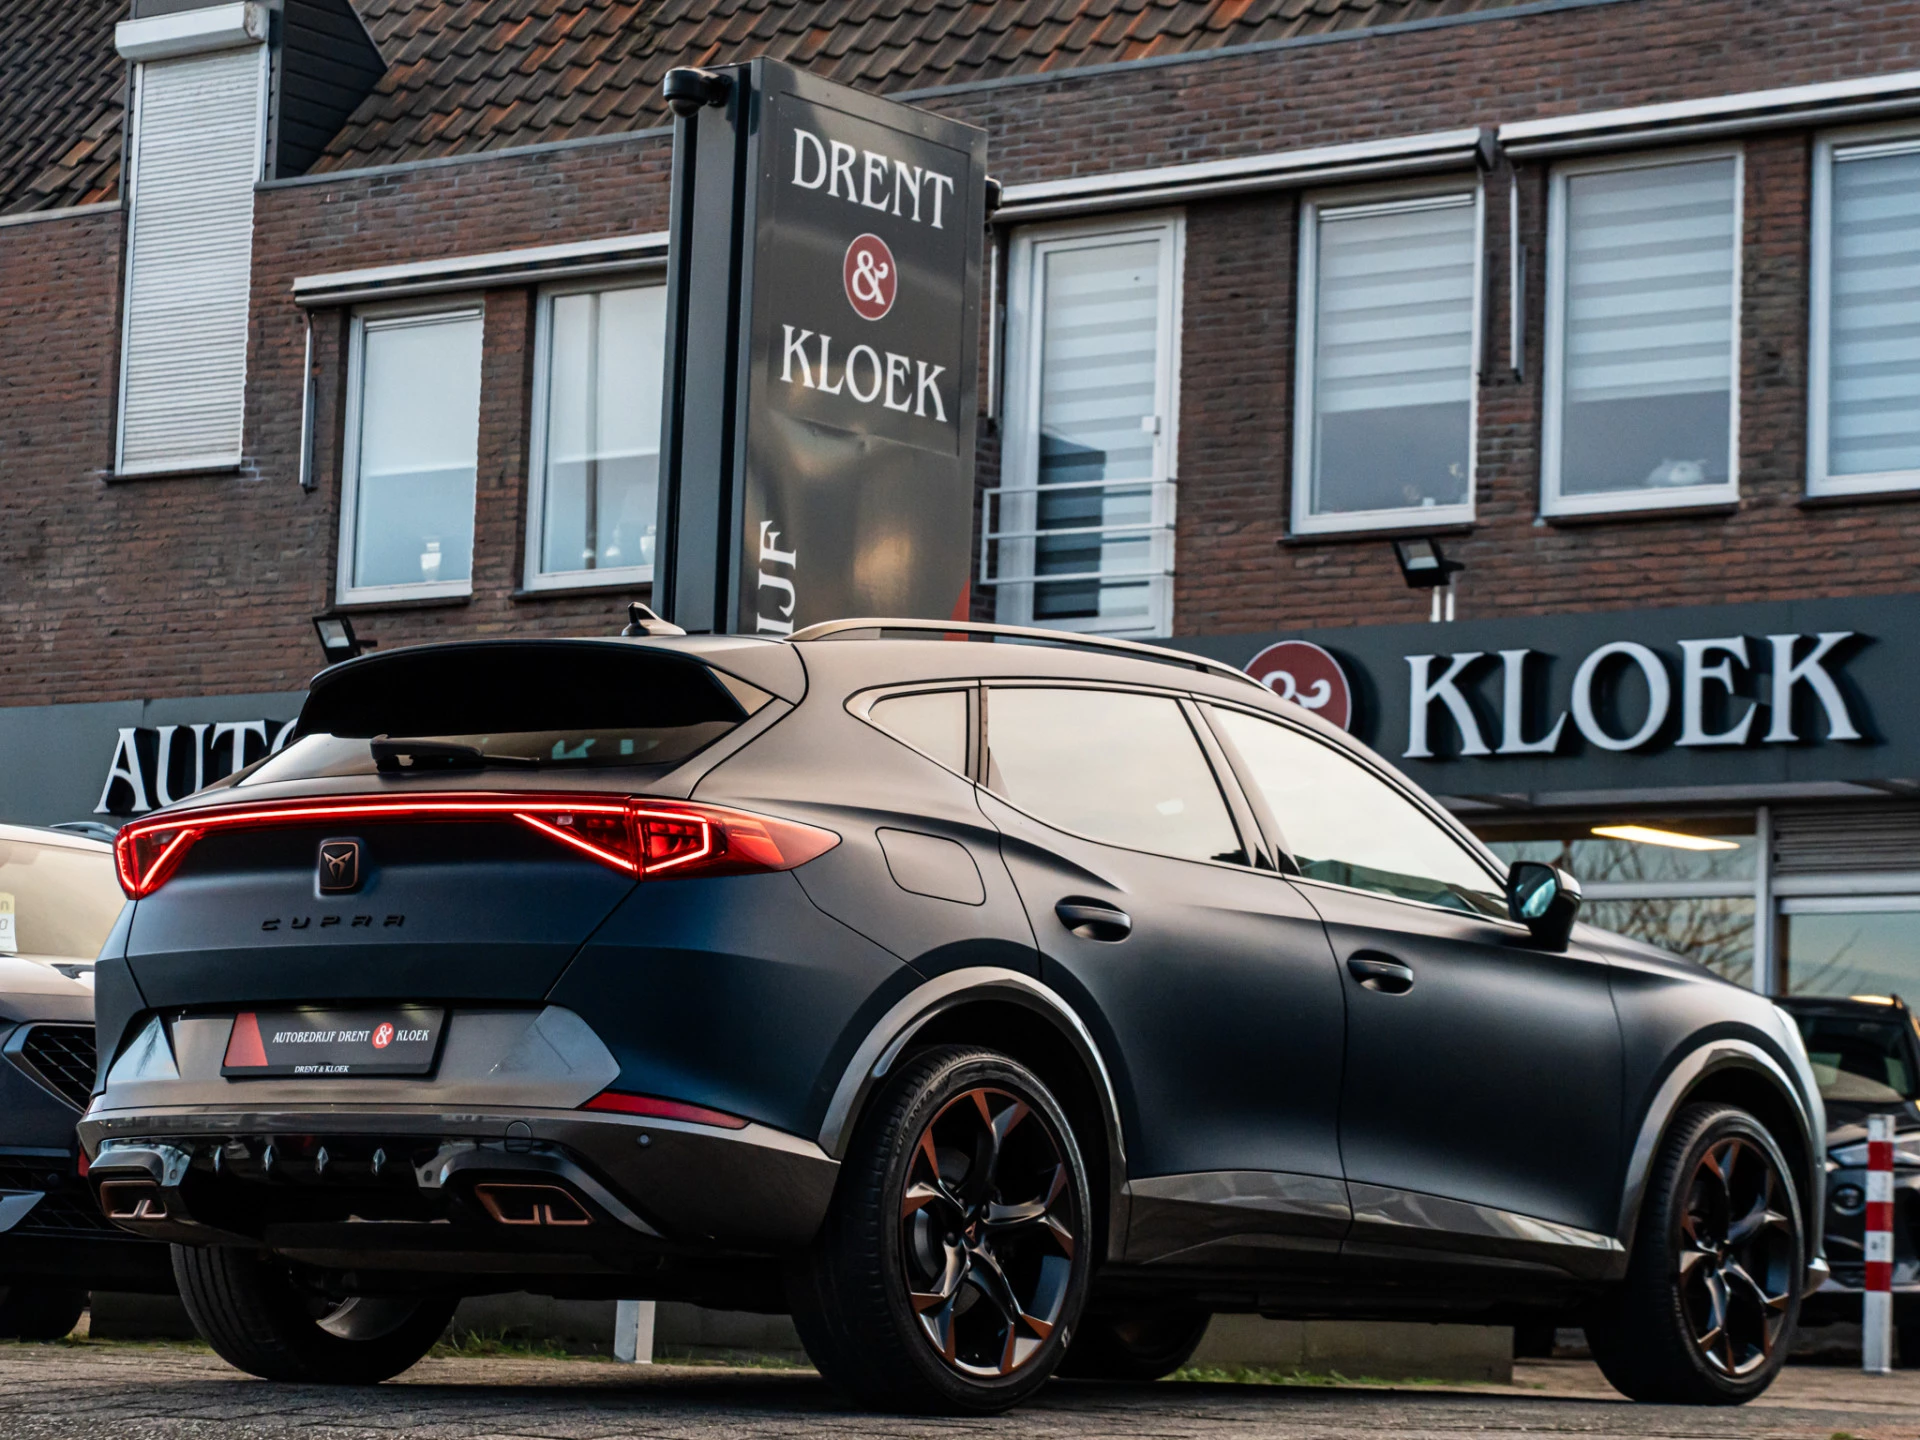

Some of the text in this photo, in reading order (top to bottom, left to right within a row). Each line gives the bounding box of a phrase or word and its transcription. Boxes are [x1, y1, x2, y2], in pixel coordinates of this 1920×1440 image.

[792, 127, 954, 229] DRENT
[852, 250, 889, 305] &
[780, 325, 948, 422] KLOEK
[1402, 632, 1862, 758] KLOEK
[262, 914, 406, 931] CUPRA
[272, 1025, 430, 1045] AUTOBEDRIJF DRENT & KLOEK
[294, 1065, 318, 1074] DRENT
[325, 1065, 350, 1073] KLOEK
